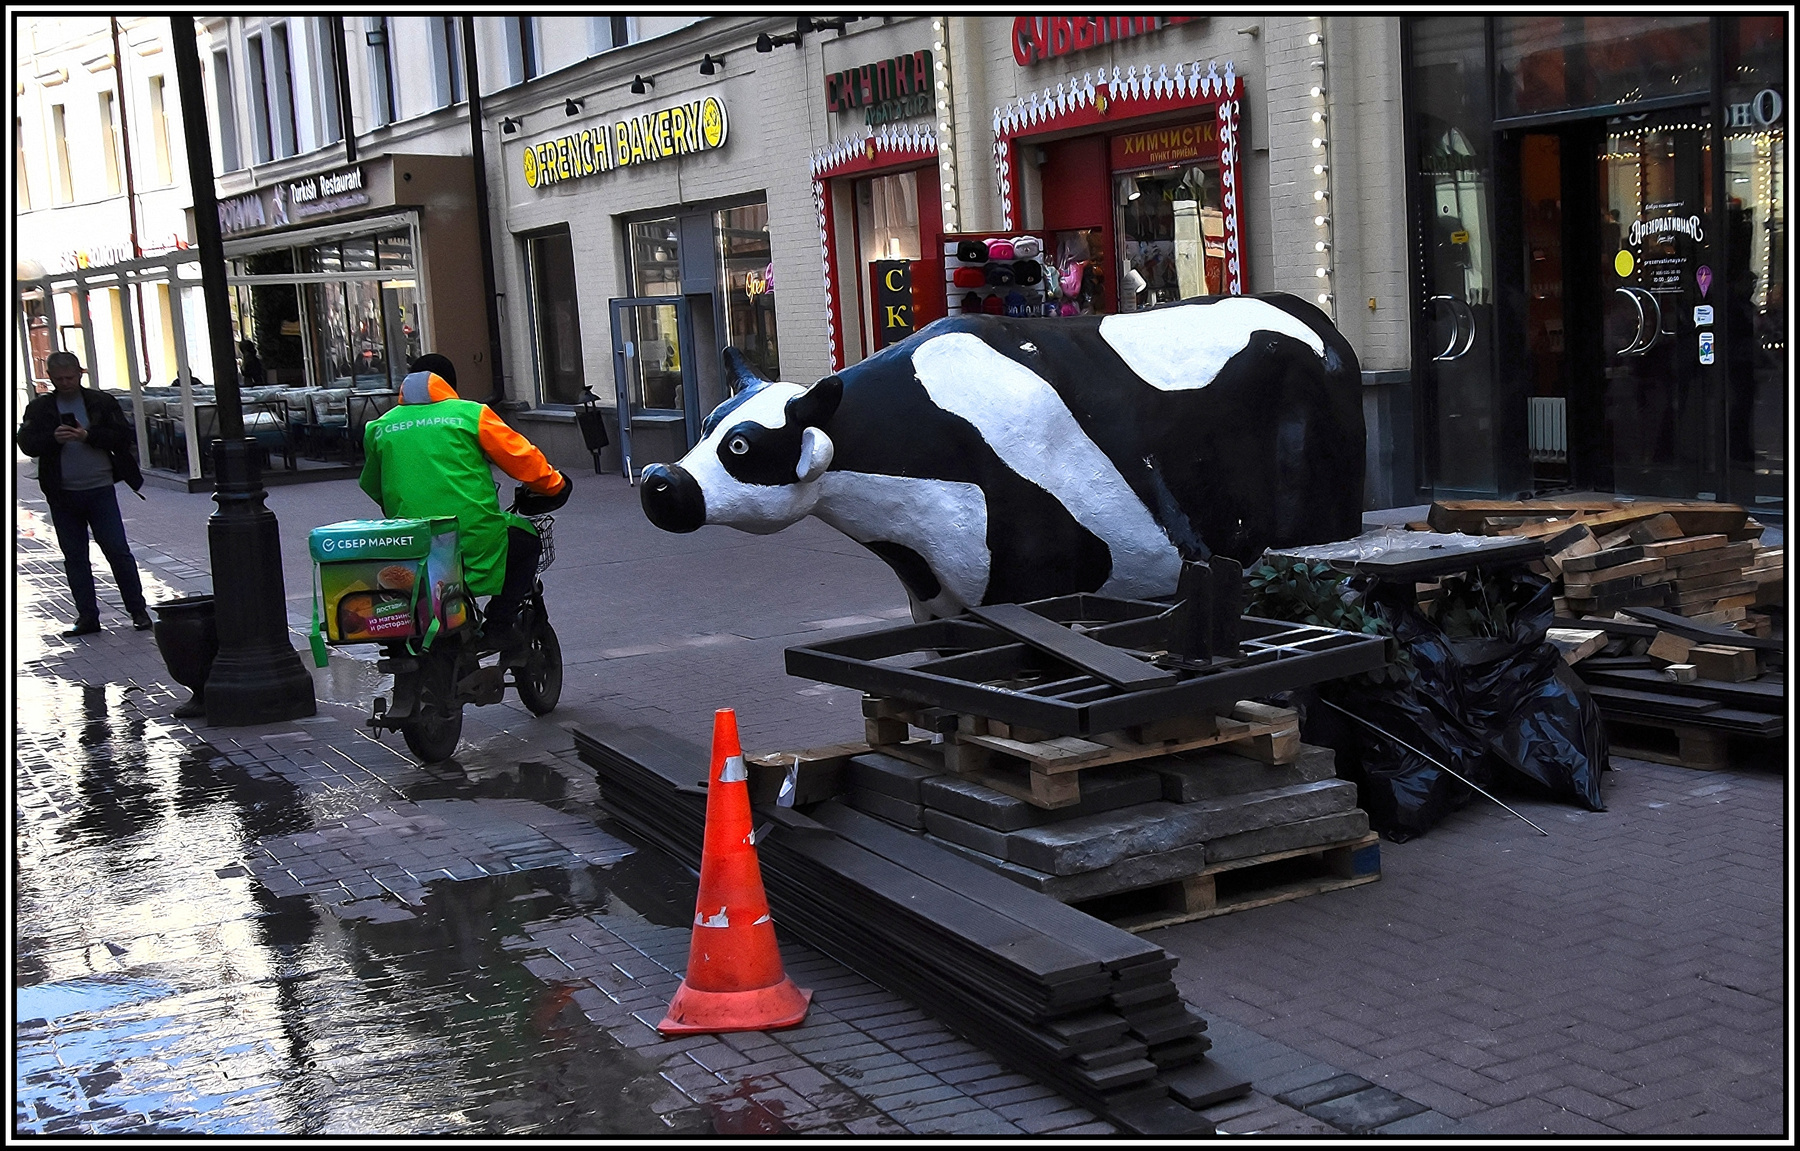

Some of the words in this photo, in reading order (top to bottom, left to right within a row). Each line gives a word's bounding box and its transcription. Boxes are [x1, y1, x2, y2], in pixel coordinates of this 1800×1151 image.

[826, 50, 932, 112] СКУПКА
[536, 125, 612, 186] FRENCH
[615, 100, 703, 166] BAKERY
[1124, 124, 1218, 154] ХИМЧИСТК
[1150, 150, 1170, 162] ПУНКТ
[1171, 146, 1198, 159] ПРИЁМА
[290, 177, 318, 204] Turkish
[319, 166, 362, 197] Restaurant
[1629, 215, 1704, 246] ПРЕЗЕРВАТИВНАЯ
[385, 421, 414, 433] СБЕР
[416, 417, 464, 428] МАРКЕТ
[337, 538, 366, 549] СБЕР
[368, 536, 414, 547] МАРКЕТ
